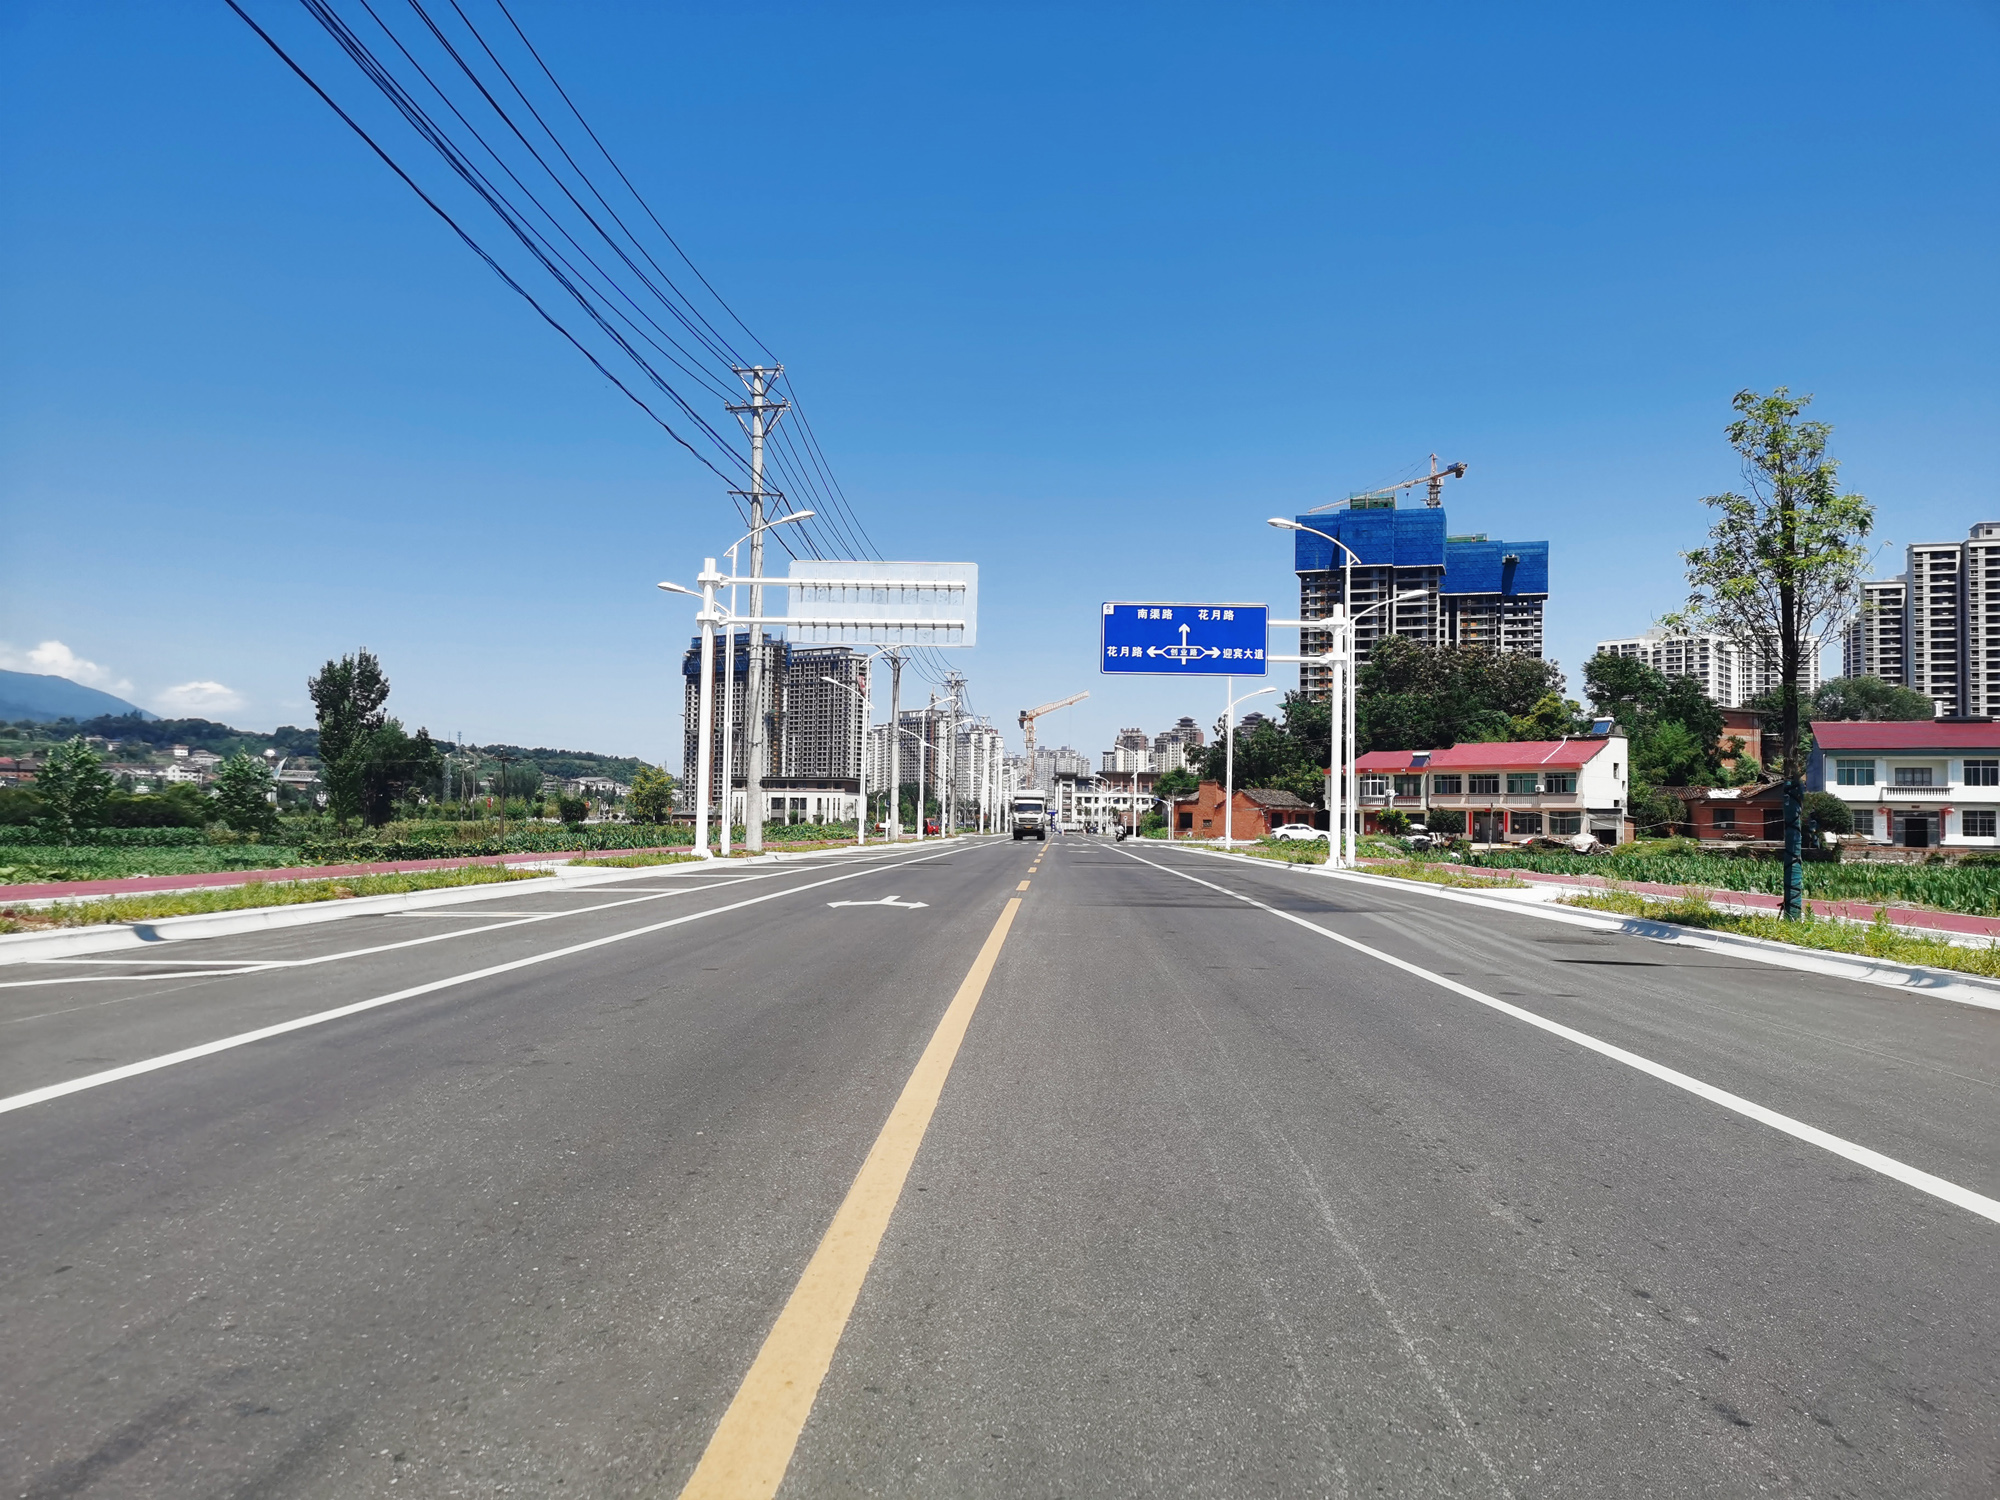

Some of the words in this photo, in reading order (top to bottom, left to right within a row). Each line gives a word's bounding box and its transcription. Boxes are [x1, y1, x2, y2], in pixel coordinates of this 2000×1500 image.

[1137, 608, 1173, 620] 南渠路
[1198, 609, 1235, 621] 花月路
[1107, 646, 1143, 658] 花月路
[1170, 648, 1198, 657] 创业路
[1222, 648, 1264, 660] 迎宾大道
